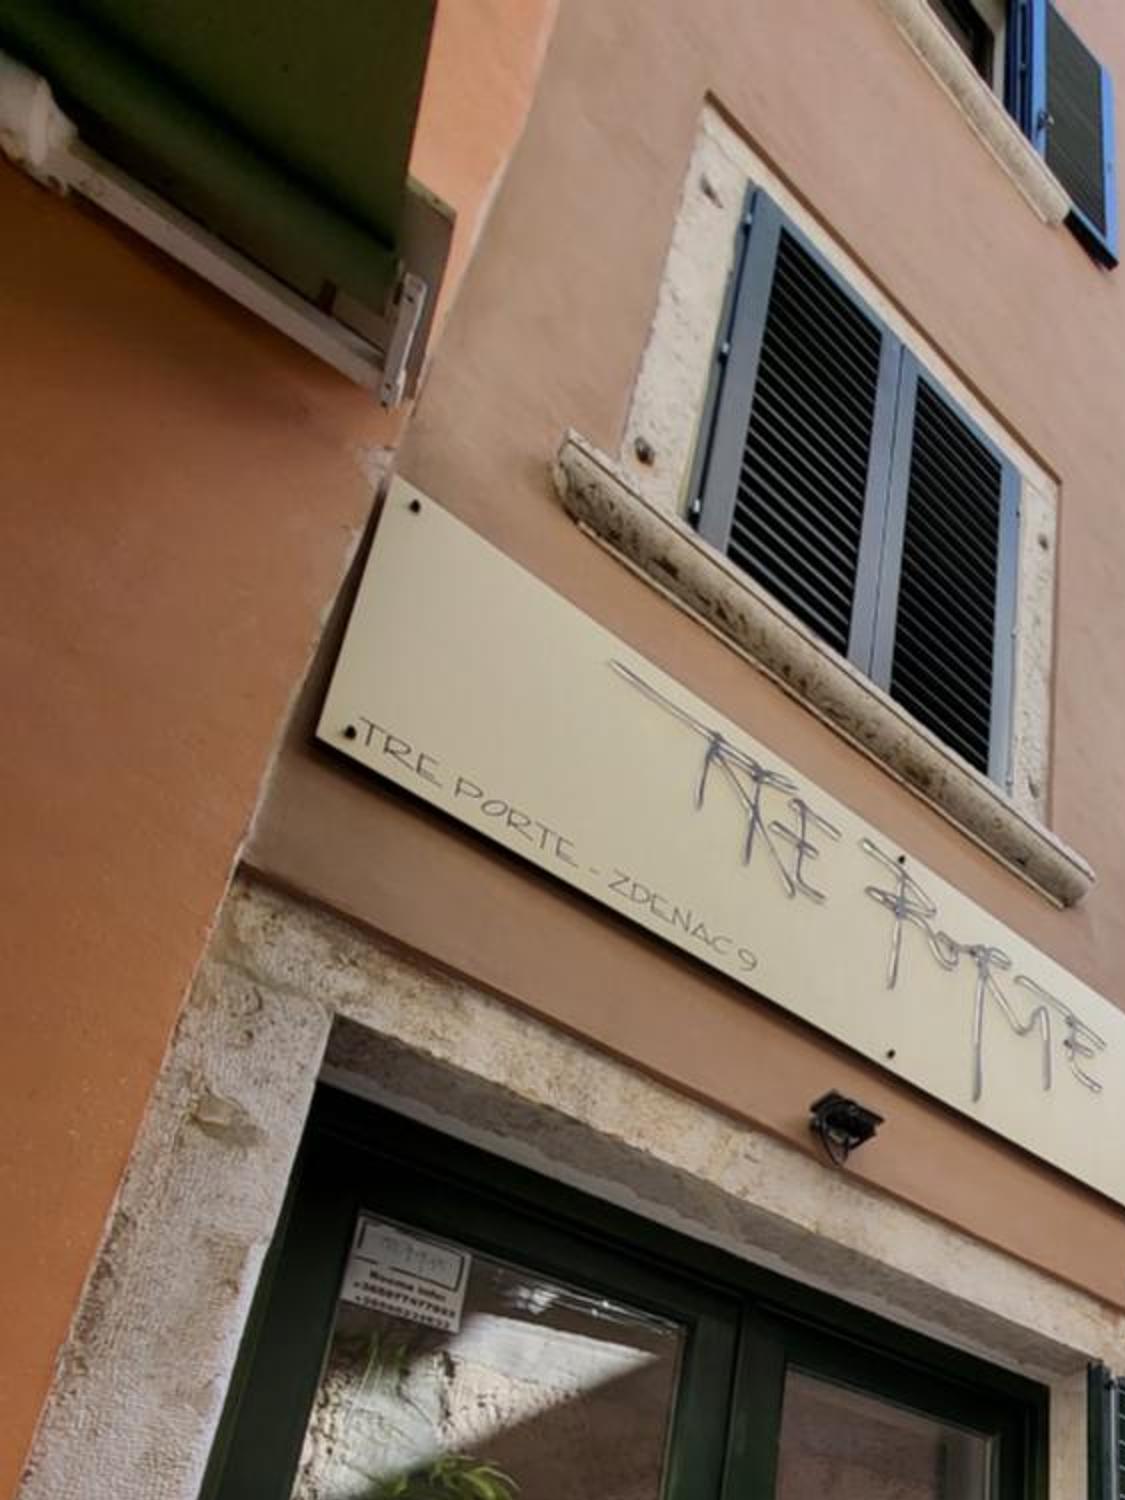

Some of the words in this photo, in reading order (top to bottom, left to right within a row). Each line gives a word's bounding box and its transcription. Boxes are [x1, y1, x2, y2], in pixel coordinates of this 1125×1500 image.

[359, 716, 443, 789] TRE
[454, 776, 580, 869] PORTE
[607, 869, 734, 956] ZDENAC
[737, 947, 759, 973] 9
